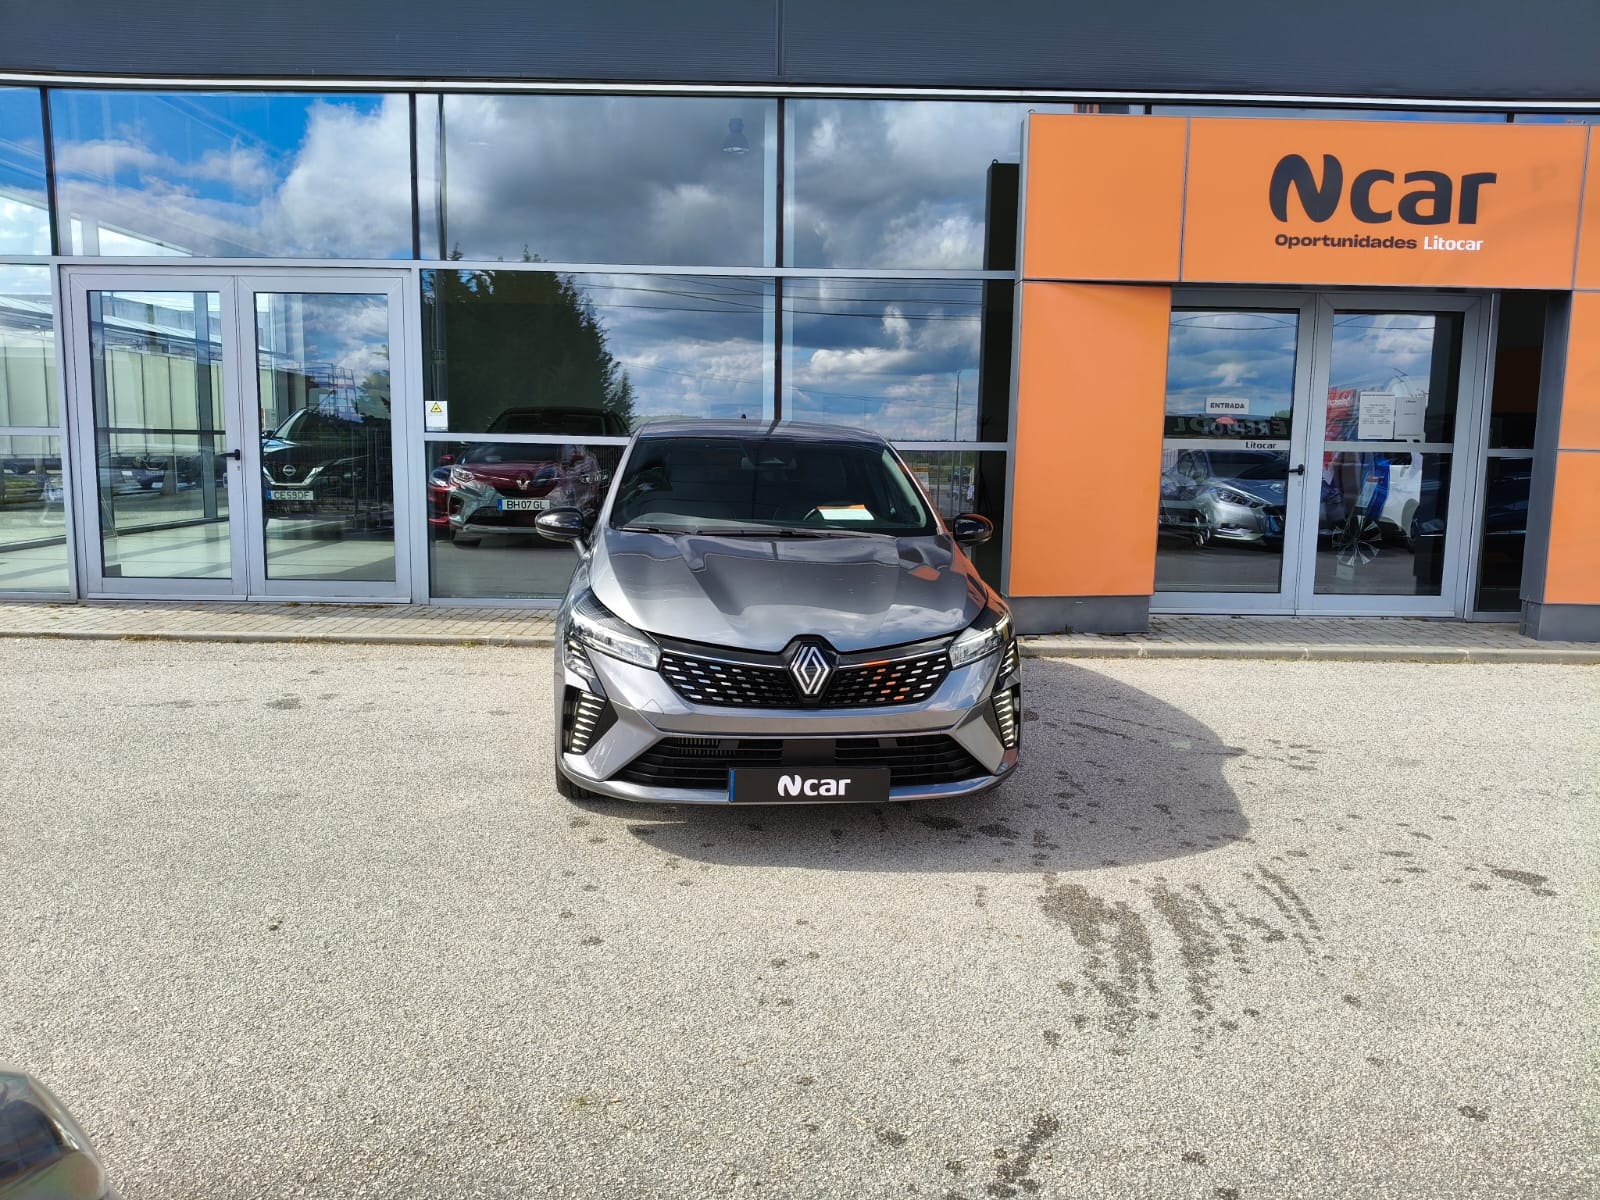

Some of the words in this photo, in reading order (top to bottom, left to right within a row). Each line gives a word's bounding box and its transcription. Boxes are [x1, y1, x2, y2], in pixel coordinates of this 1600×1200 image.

[1269, 153, 1497, 225] Ncar
[1274, 234, 1417, 249] Oportunidades
[1423, 235, 1484, 251] Litocar
[1245, 441, 1277, 449] Litocar
[777, 774, 852, 797] Ncar
